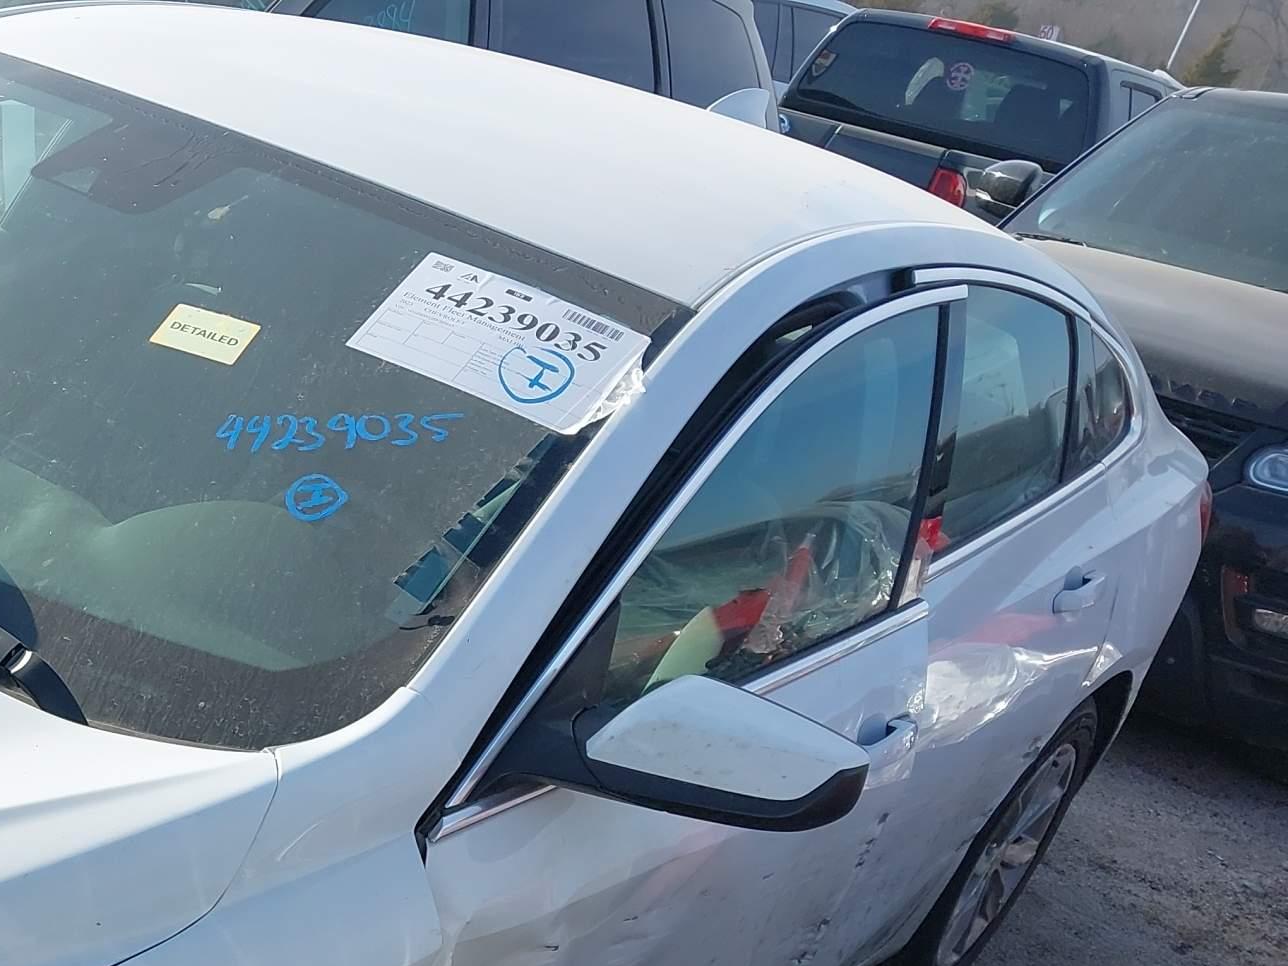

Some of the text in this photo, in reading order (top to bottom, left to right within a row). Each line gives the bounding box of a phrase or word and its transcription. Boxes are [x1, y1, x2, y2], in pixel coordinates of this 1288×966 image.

[170, 320, 239, 348] DETAILED
[402, 290, 442, 309] Element
[440, 304, 467, 318] Fleet
[465, 314, 527, 342] Management
[424, 284, 608, 363] 44239035
